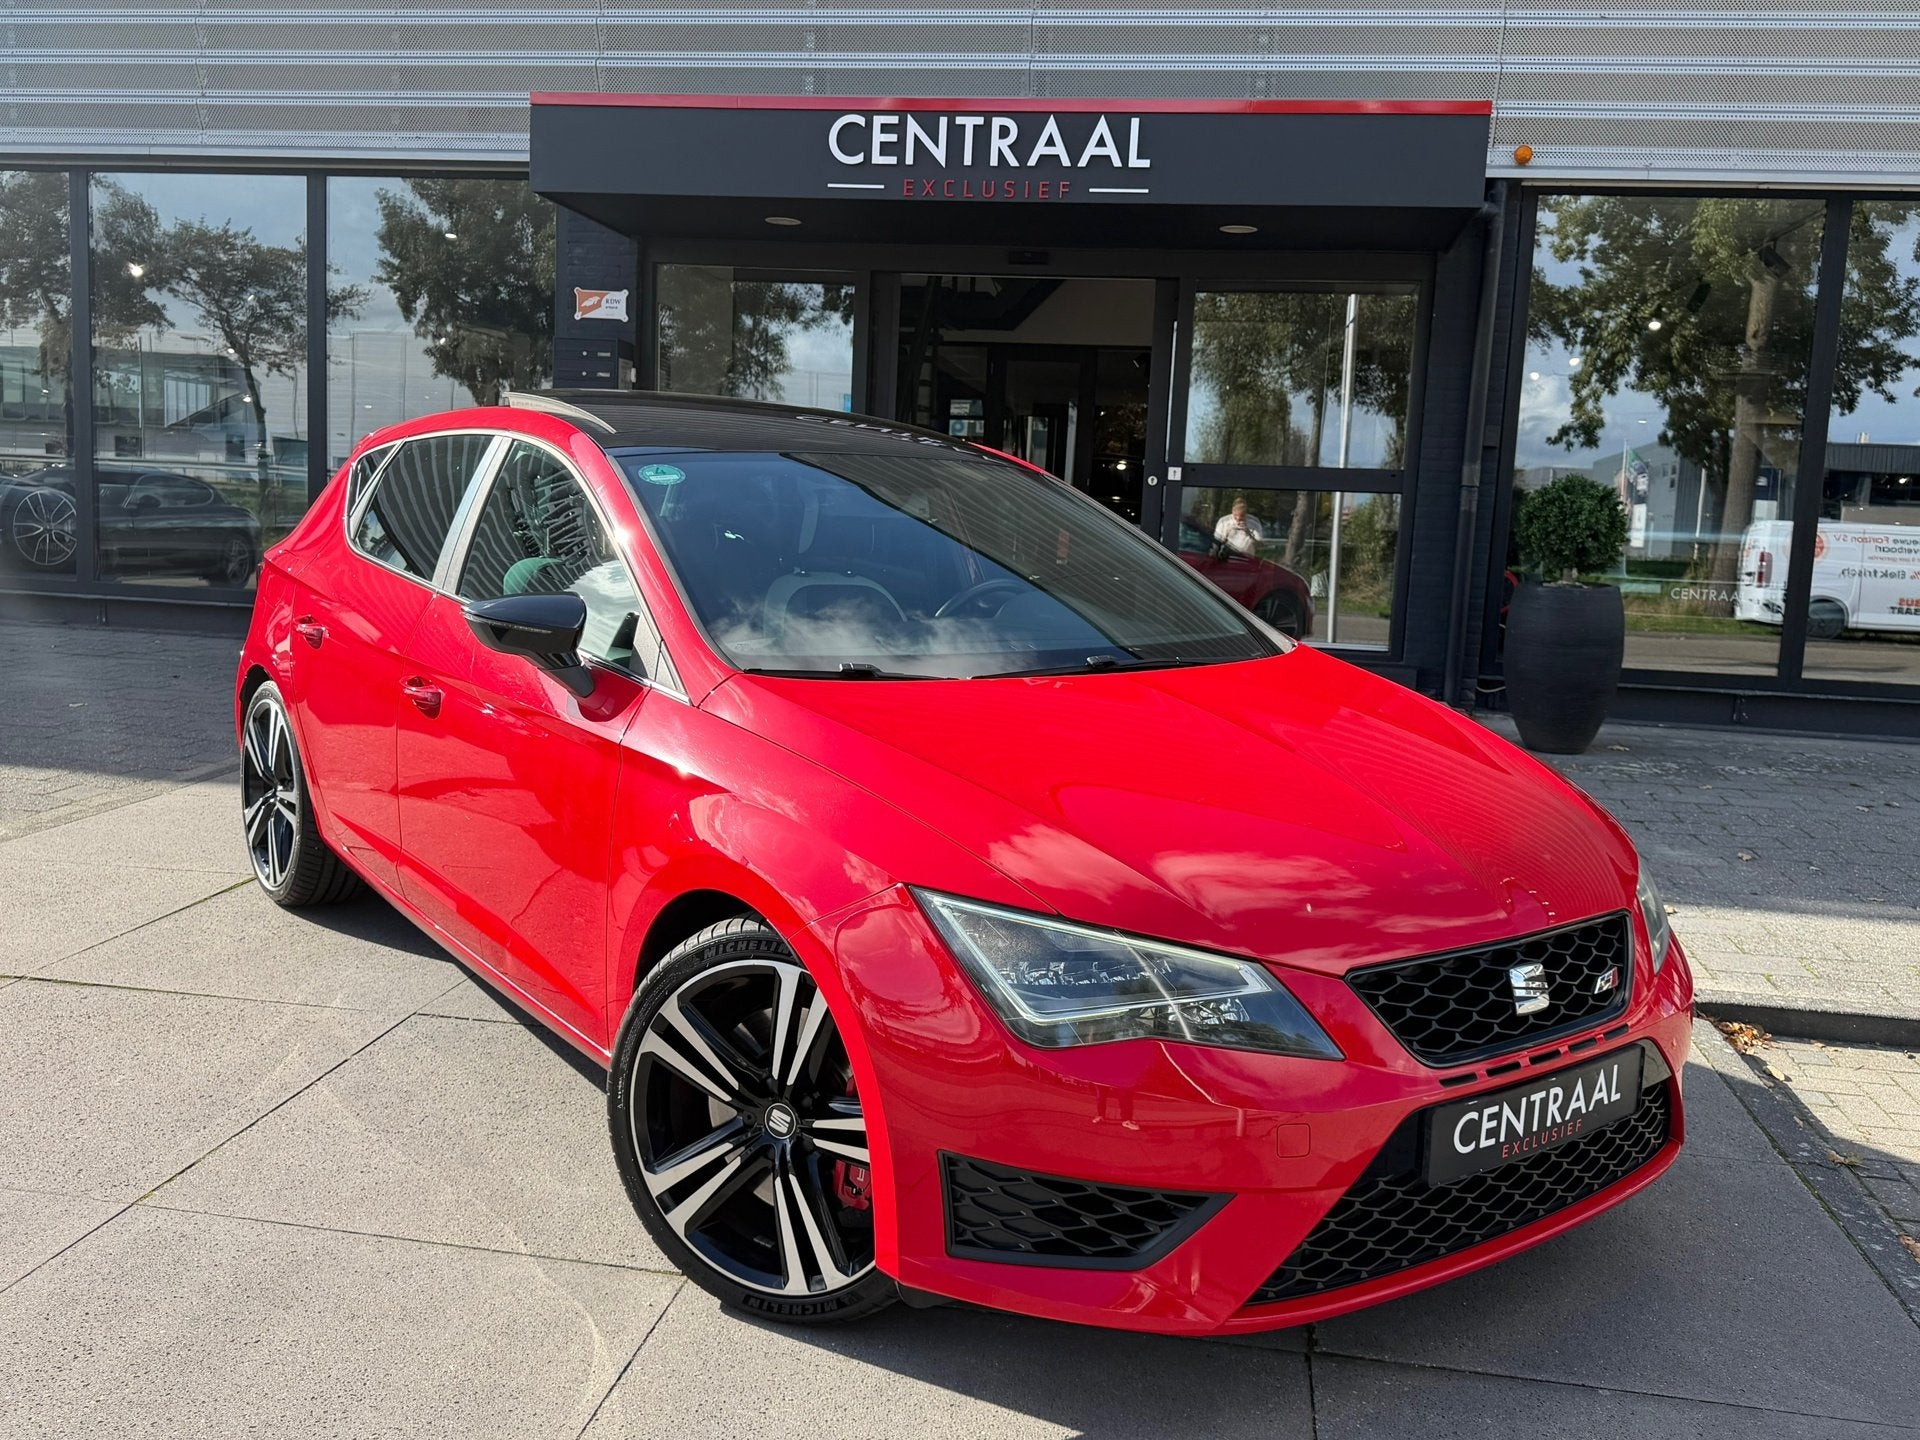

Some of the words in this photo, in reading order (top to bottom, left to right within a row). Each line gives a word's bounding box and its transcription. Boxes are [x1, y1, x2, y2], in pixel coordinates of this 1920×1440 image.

[828, 113, 1151, 168] CENTRAAL
[903, 179, 1071, 199] EXCLUSIEF
[703, 940, 791, 960] MICHELIN
[1453, 1064, 1622, 1154] CENTRAAL
[1502, 1120, 1583, 1158] EXCLUSIEF
[746, 1295, 838, 1315] MICHELIN
